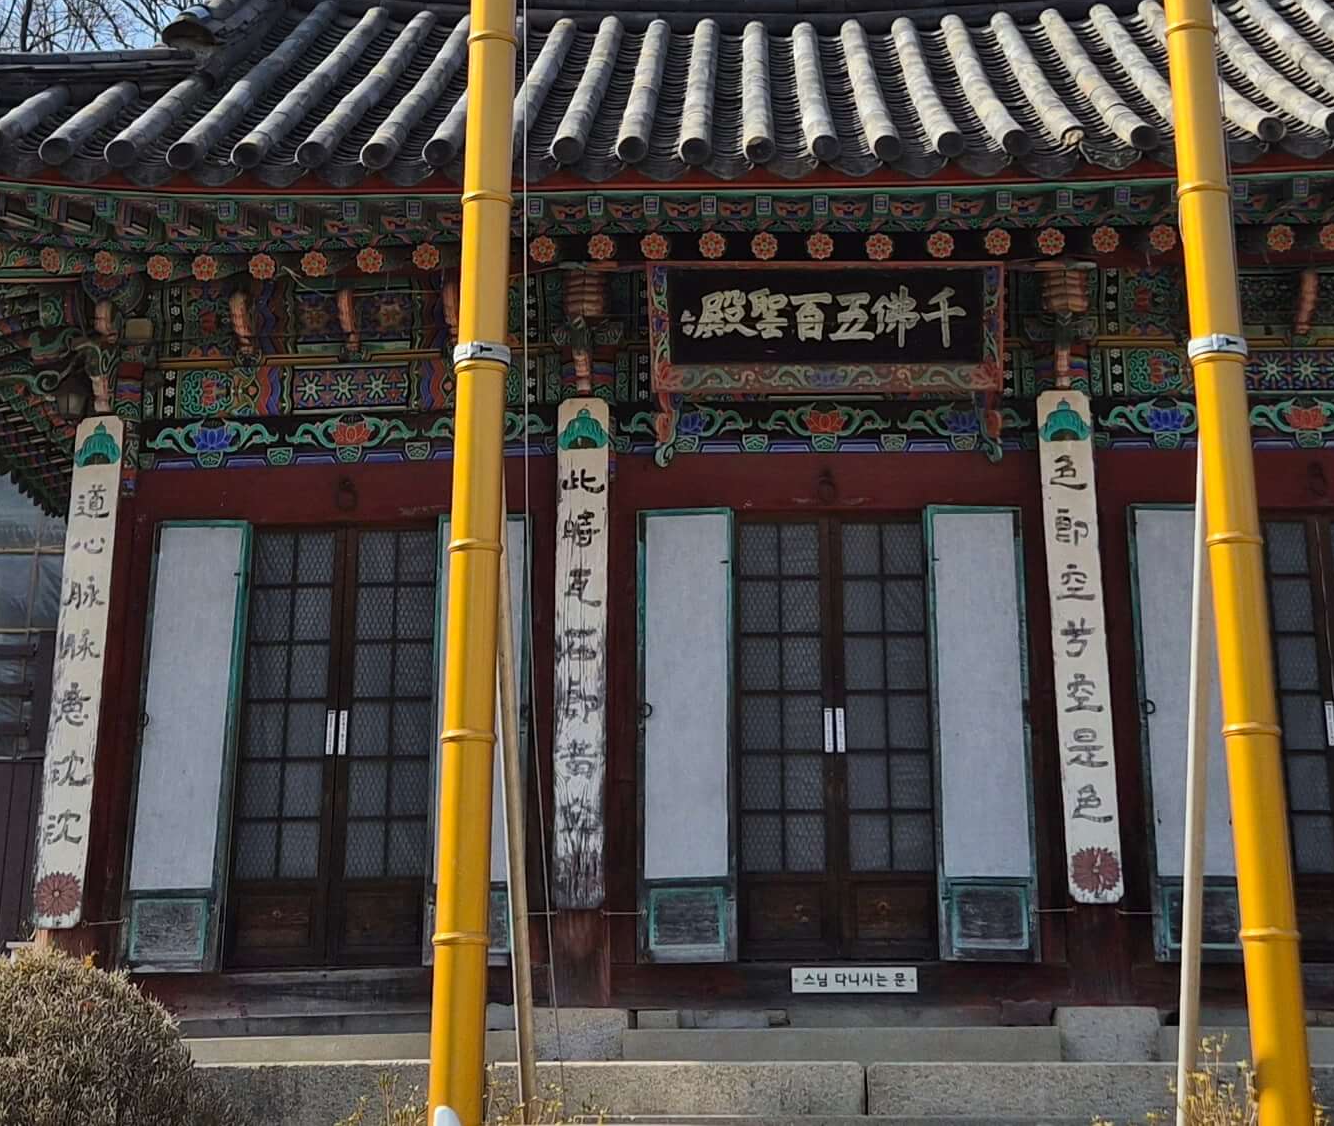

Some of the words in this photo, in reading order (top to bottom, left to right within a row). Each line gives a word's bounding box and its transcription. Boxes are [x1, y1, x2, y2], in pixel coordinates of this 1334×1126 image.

[802, 972, 828, 987] 스님
[834, 972, 889, 987] 다니시는
[893, 972, 907, 987] 문
